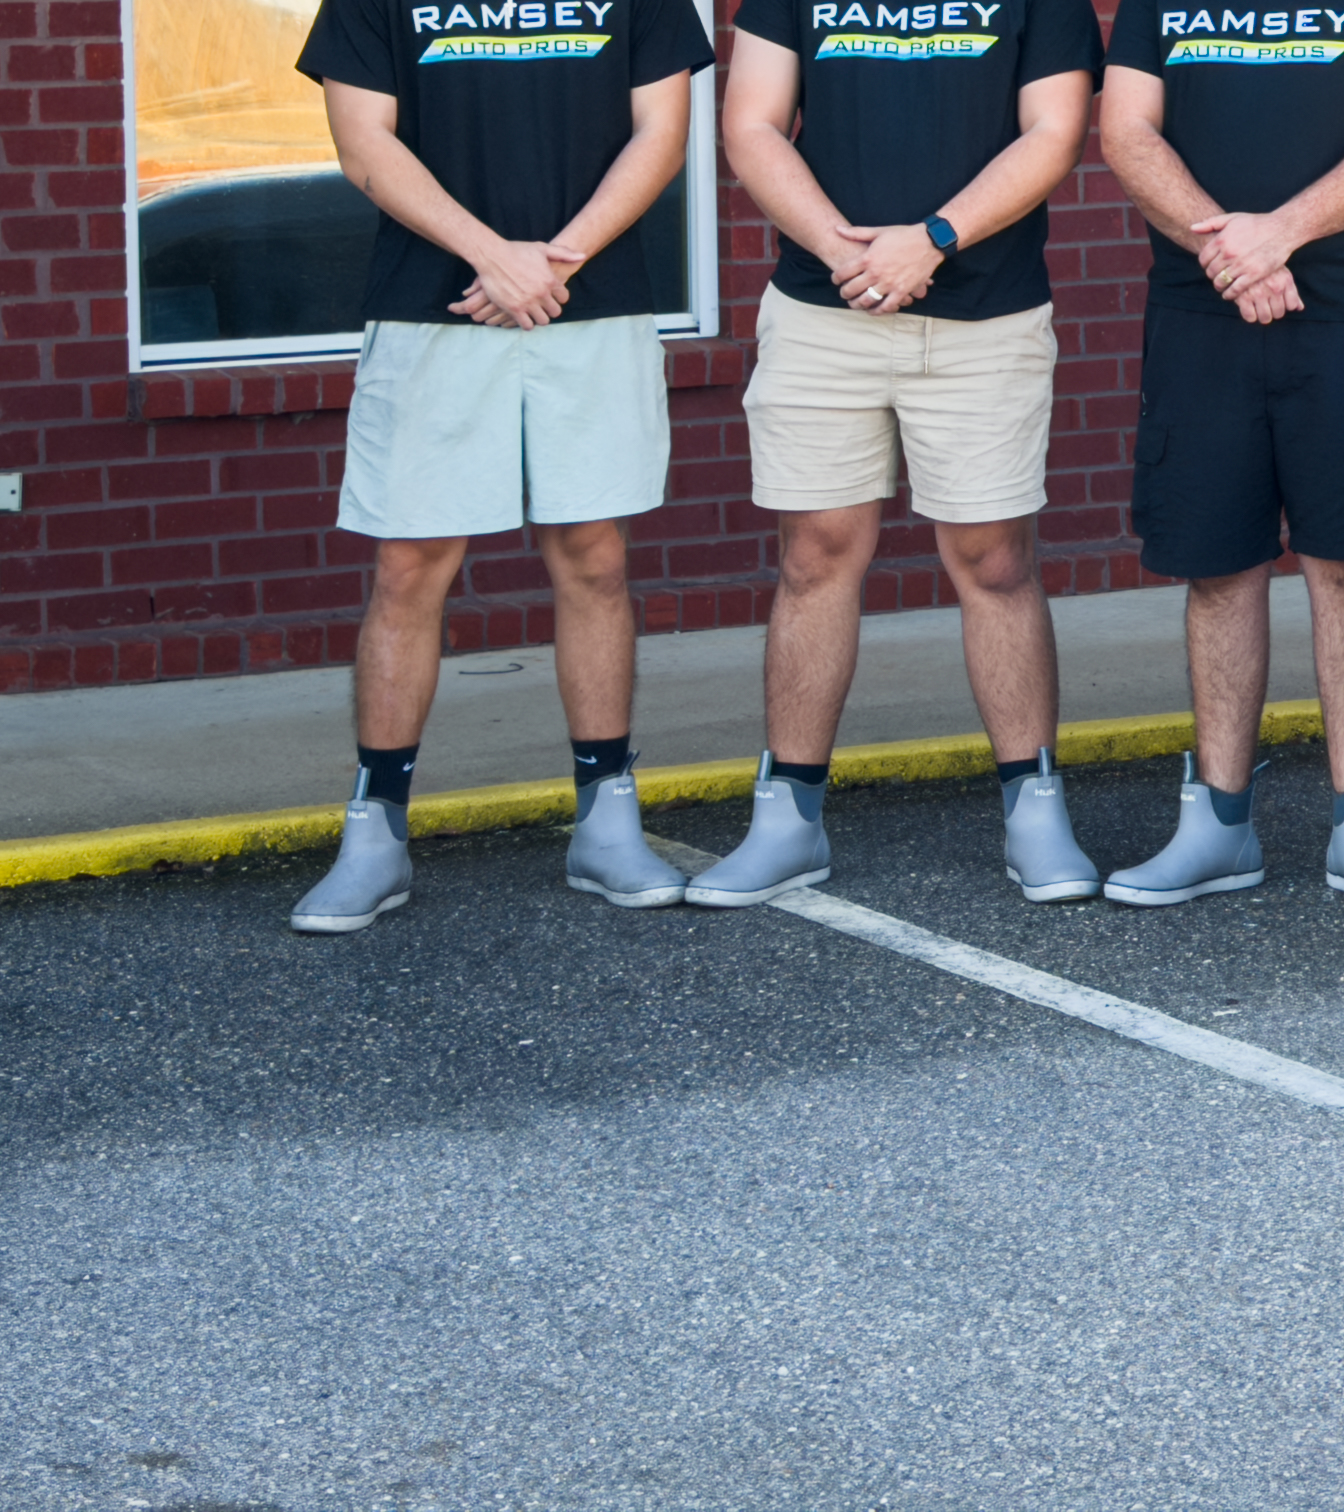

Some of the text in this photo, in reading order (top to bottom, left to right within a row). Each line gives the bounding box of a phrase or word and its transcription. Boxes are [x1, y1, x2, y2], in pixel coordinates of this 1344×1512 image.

[412, 1, 613, 33] RAMSEY
[813, 2, 1001, 31] RAMSEY
[442, 40, 588, 56] AUTO PROS
[834, 39, 973, 55] AUTO PROS
[1180, 46, 1325, 59] AUTO PROS
